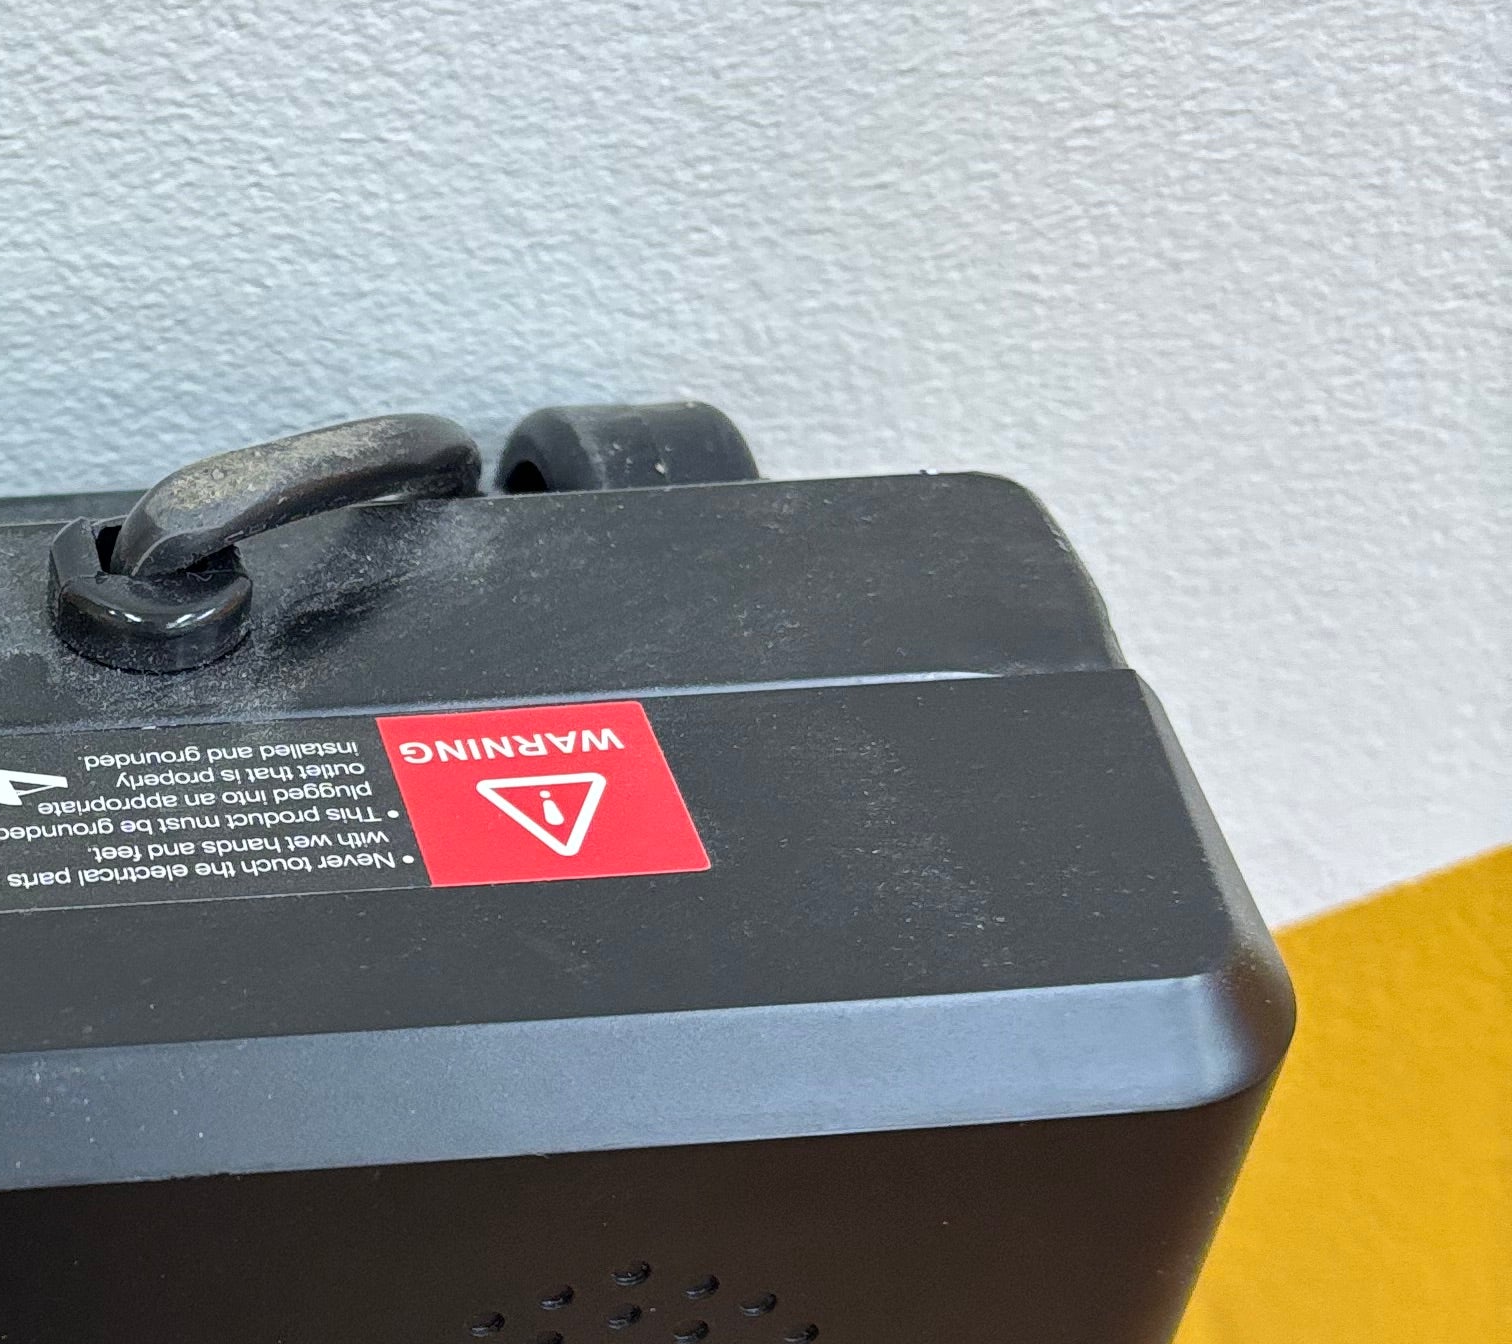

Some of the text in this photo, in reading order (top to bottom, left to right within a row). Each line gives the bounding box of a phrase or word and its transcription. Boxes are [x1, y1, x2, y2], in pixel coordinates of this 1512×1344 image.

[77, 741, 360, 772] installed and grounded.
[397, 726, 626, 765] WARNING
[115, 762, 366, 791] outlet that is properly
[37, 780, 373, 817] plugged into an appropriate
[156, 814, 221, 834] must
[224, 805, 321, 830] product
[325, 806, 383, 824] This
[120, 819, 153, 836] be
[87, 830, 390, 864] with wet hands and feet.
[194, 861, 237, 879] the
[240, 856, 313, 877] touch
[317, 851, 396, 869] Never
[6, 866, 72, 890] parts
[77, 863, 189, 887] electrical
